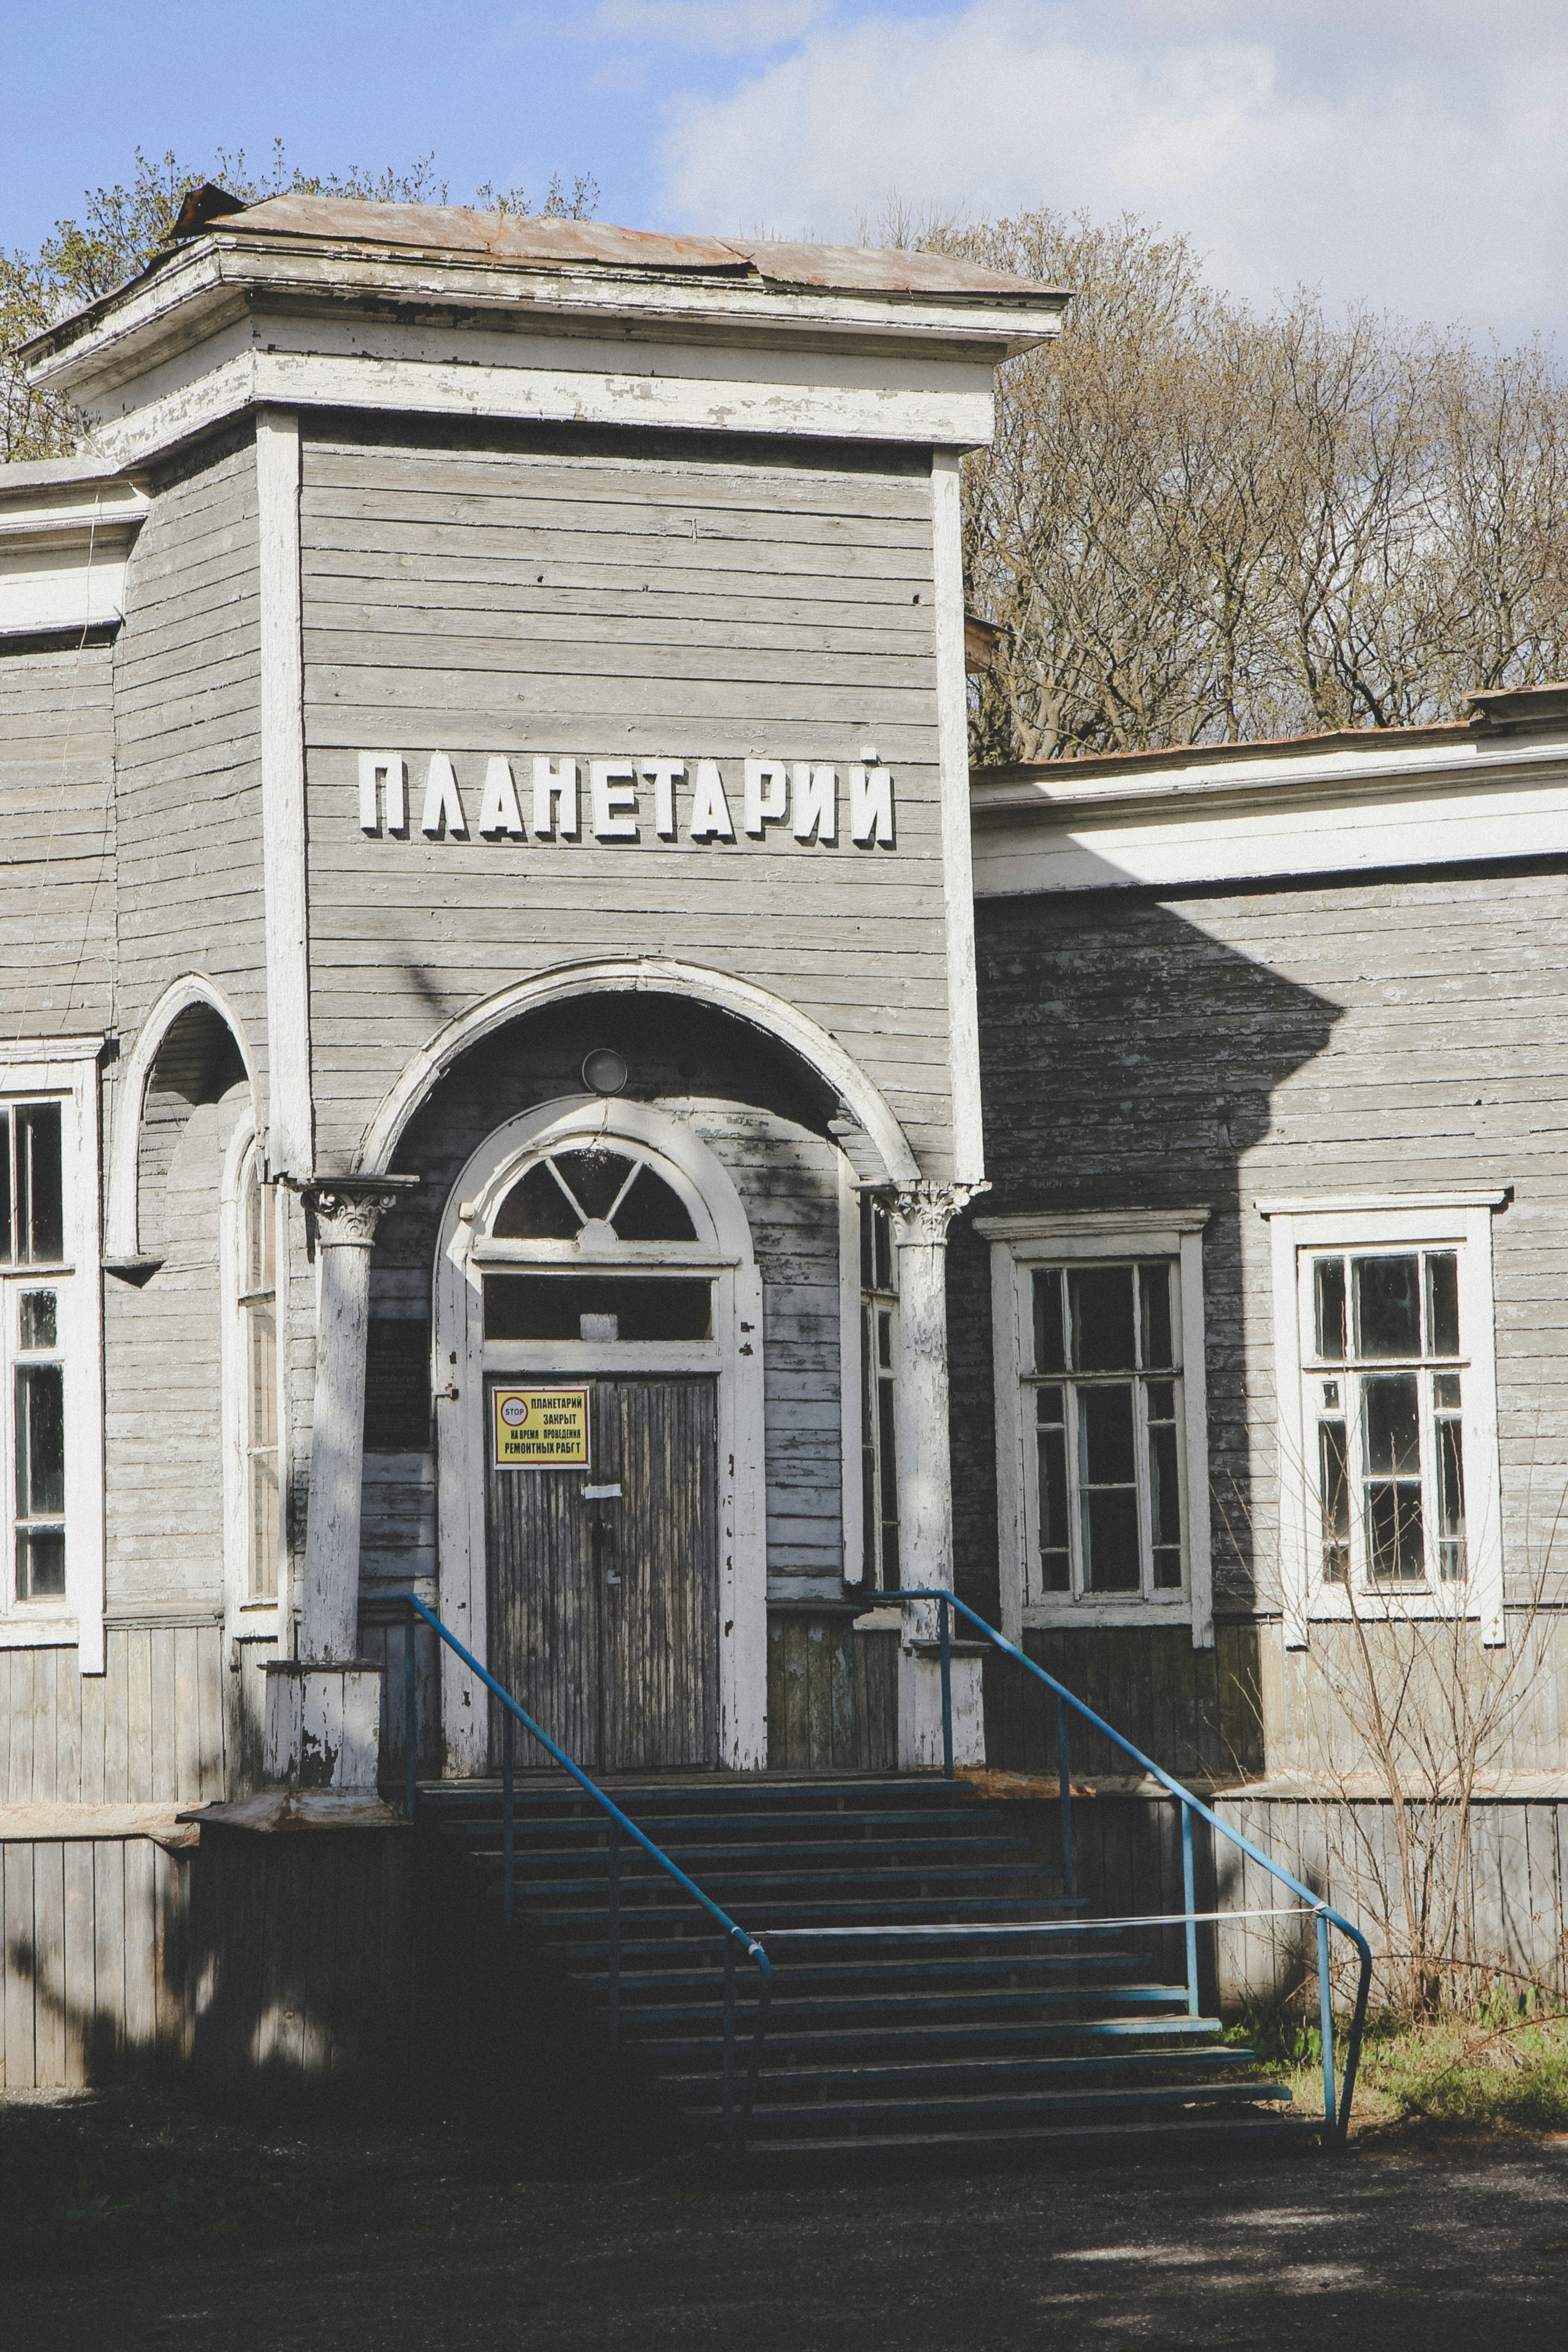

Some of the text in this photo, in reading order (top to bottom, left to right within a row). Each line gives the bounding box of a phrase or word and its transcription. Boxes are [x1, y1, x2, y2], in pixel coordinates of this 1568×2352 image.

[358, 747, 892, 841] ПЛАНЕТАРИЙ
[531, 1396, 582, 1409] ПЛАНЕТАРИЙ
[544, 1414, 576, 1425] ЗАКРЫТ
[511, 1429, 580, 1440] НА ВРЕМЯ ПРОВЕДЕНИЯ
[505, 1442, 554, 1454] РЕМОНТНЫХ
